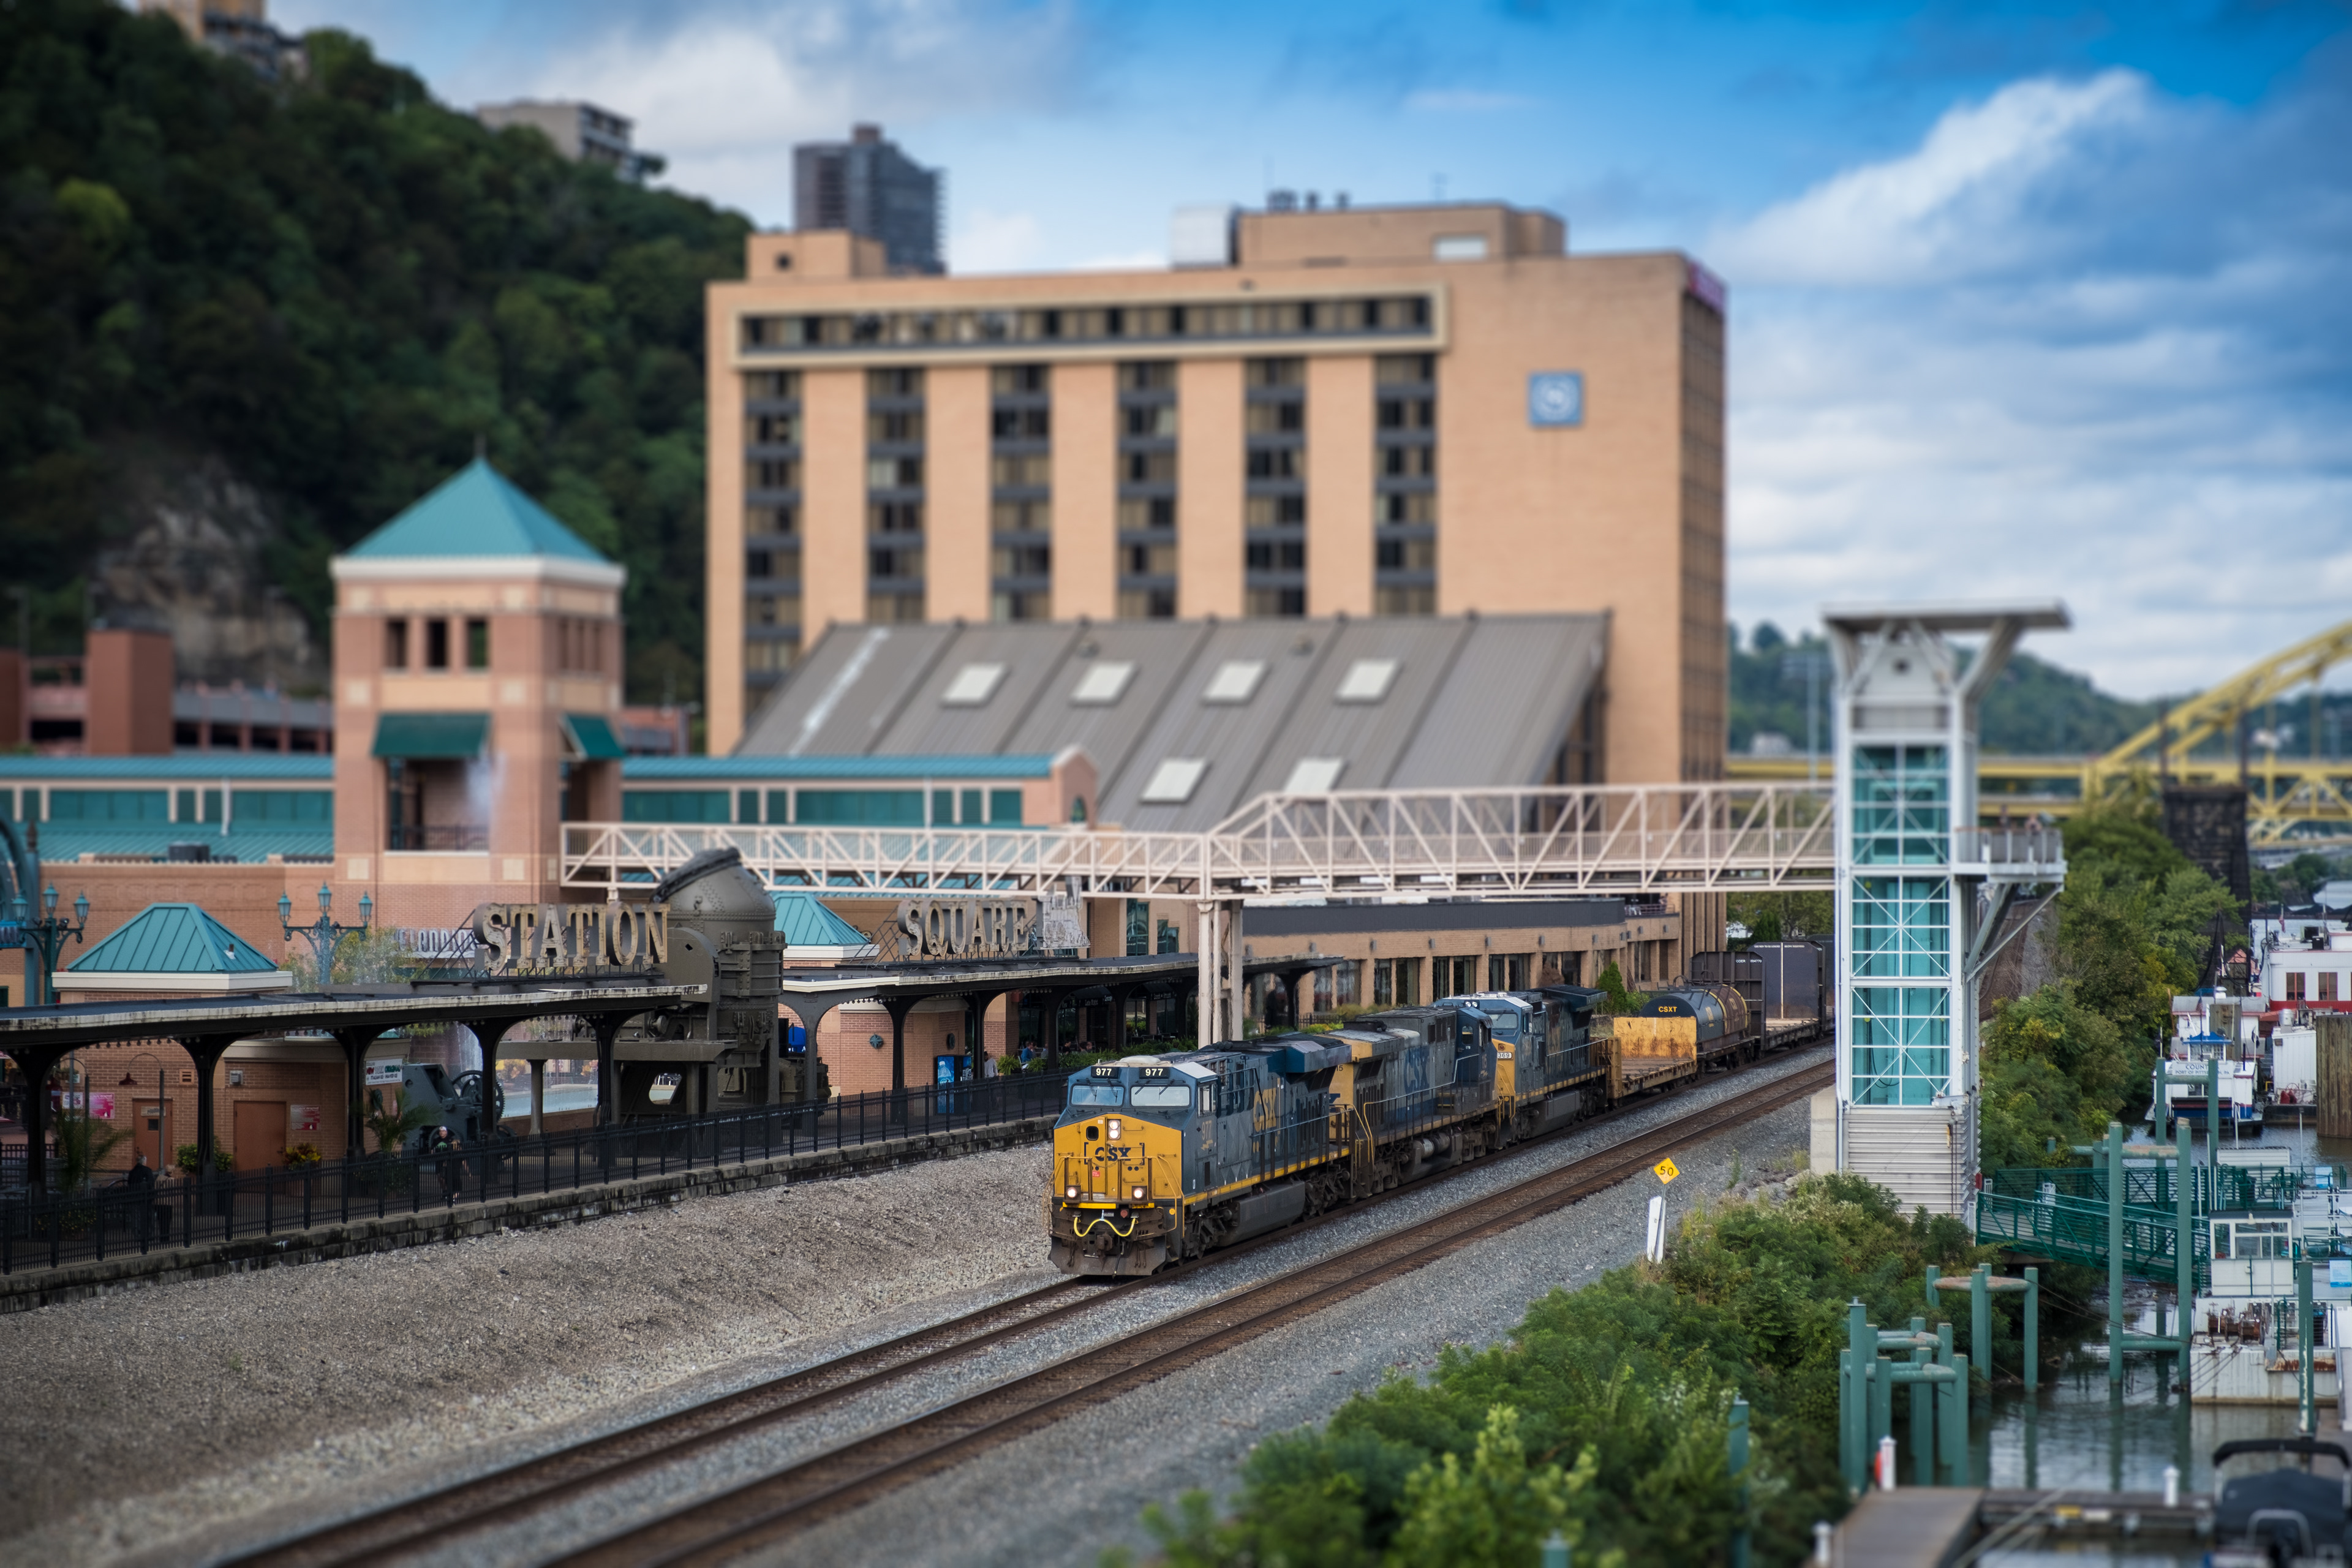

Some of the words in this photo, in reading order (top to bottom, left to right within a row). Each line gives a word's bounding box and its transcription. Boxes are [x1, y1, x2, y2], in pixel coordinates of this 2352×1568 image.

[478, 902, 671, 971] STATION
[900, 899, 1029, 957] SQUARE
[1096, 1068, 1112, 1076] 977
[1253, 1087, 1276, 1132] CSX
[1202, 1120, 1212, 1140] 977
[1095, 1147, 1131, 1161] CSX
[1660, 1166, 1674, 1177] 50
